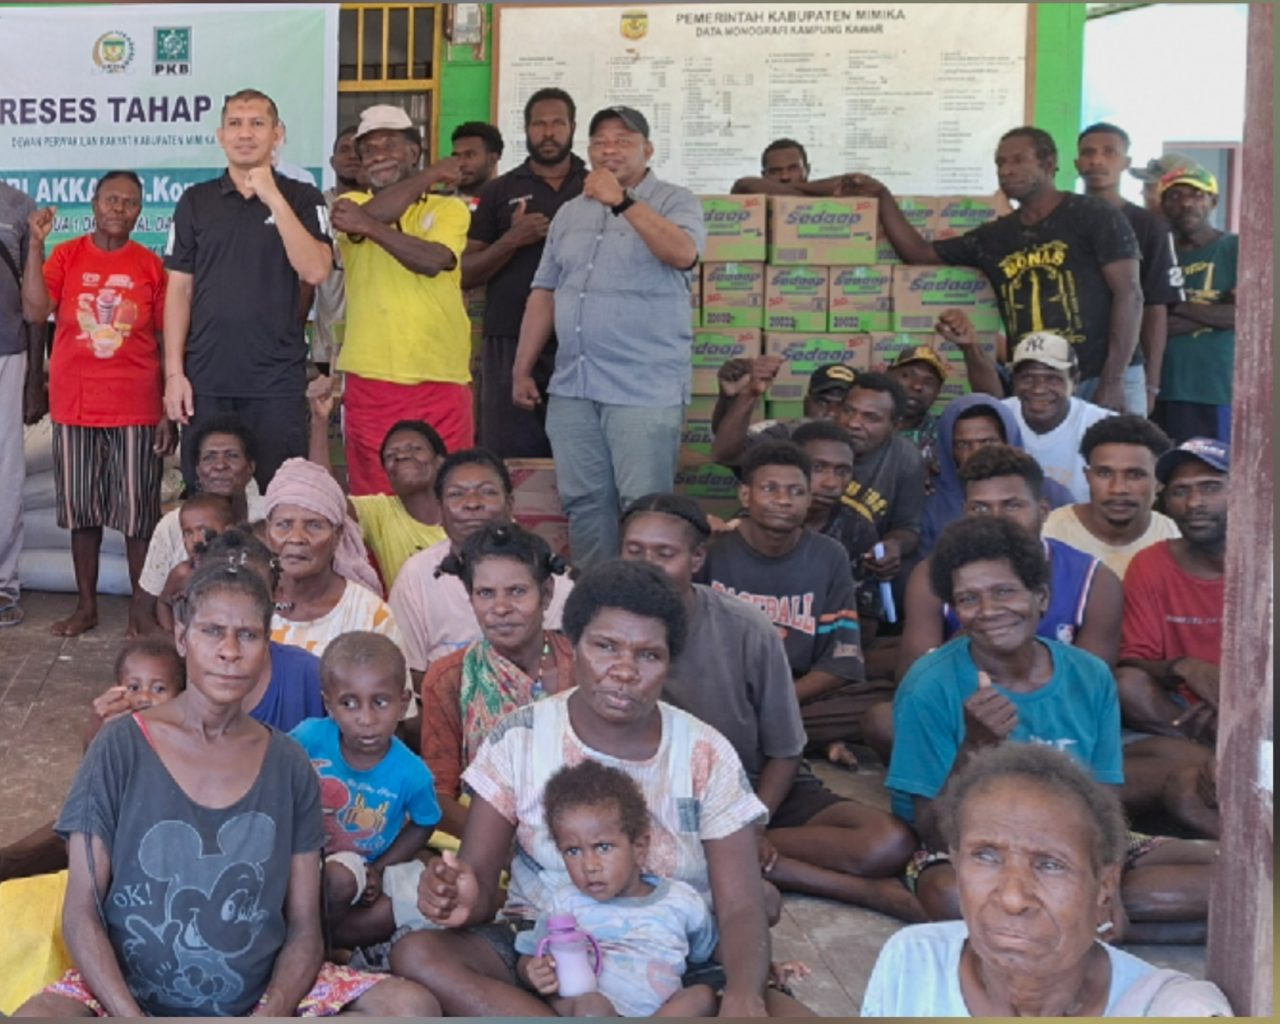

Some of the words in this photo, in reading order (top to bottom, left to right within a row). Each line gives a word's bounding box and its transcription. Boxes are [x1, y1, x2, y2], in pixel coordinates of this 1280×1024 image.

[676, 12, 764, 24] PEMERINTAH
[768, 10, 851, 23] KABUPATEN
[856, 9, 906, 20] MIMIKA
[696, 27, 721, 37] DATA
[790, 24, 842, 35] KAMPUNG
[155, 64, 189, 74] PKB
[108, 96, 211, 123] TAHAP
